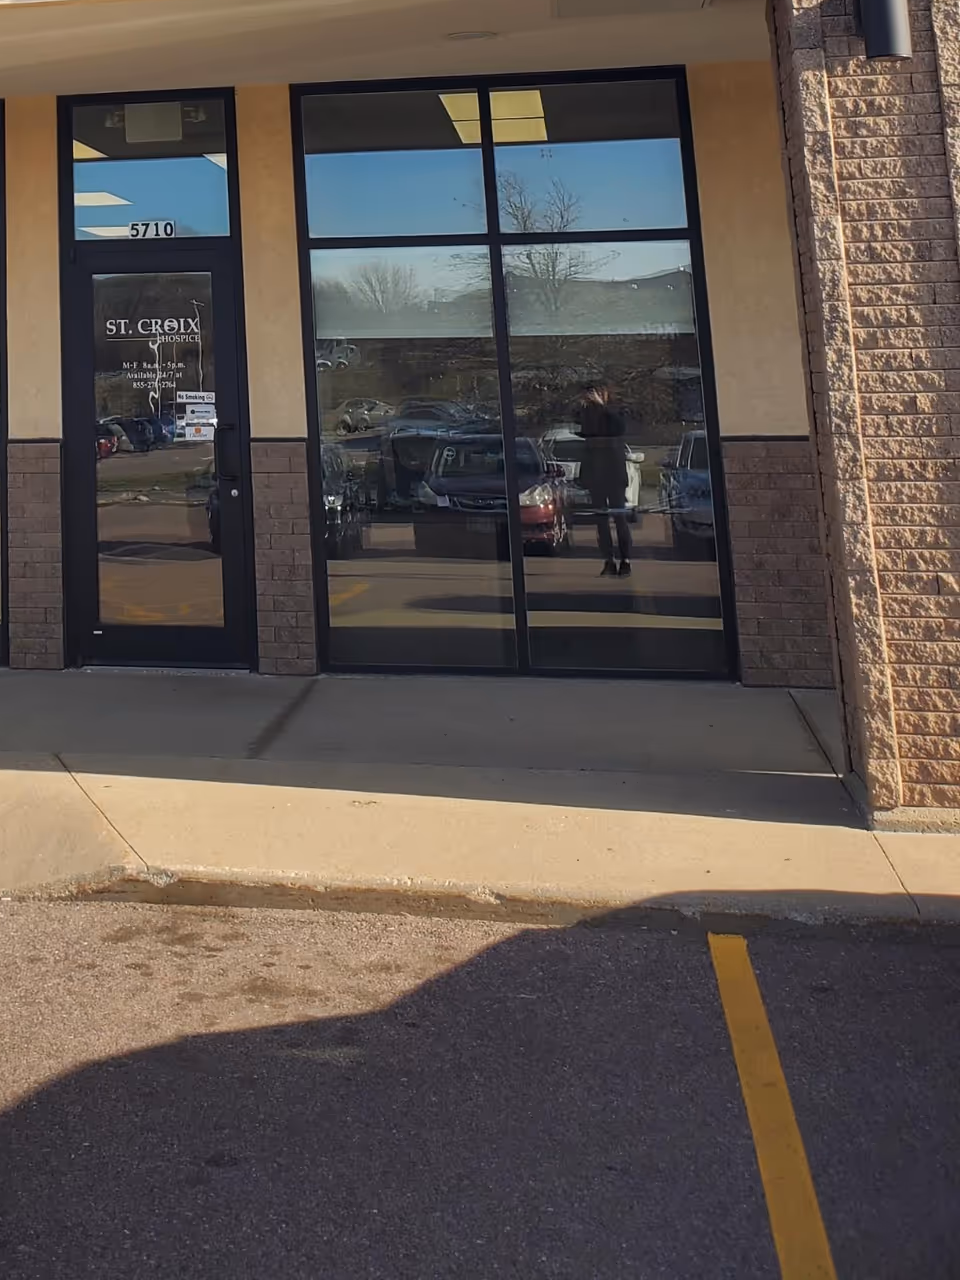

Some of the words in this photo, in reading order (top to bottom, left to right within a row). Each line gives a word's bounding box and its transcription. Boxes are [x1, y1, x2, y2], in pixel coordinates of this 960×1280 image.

[130, 222, 174, 238] 5710
[106, 319, 133, 335] ST.
[137, 318, 200, 334] CROIX
[161, 334, 200, 343] HOSPICE
[126, 371, 157, 380] Available
[185, 393, 206, 402] Smoking
